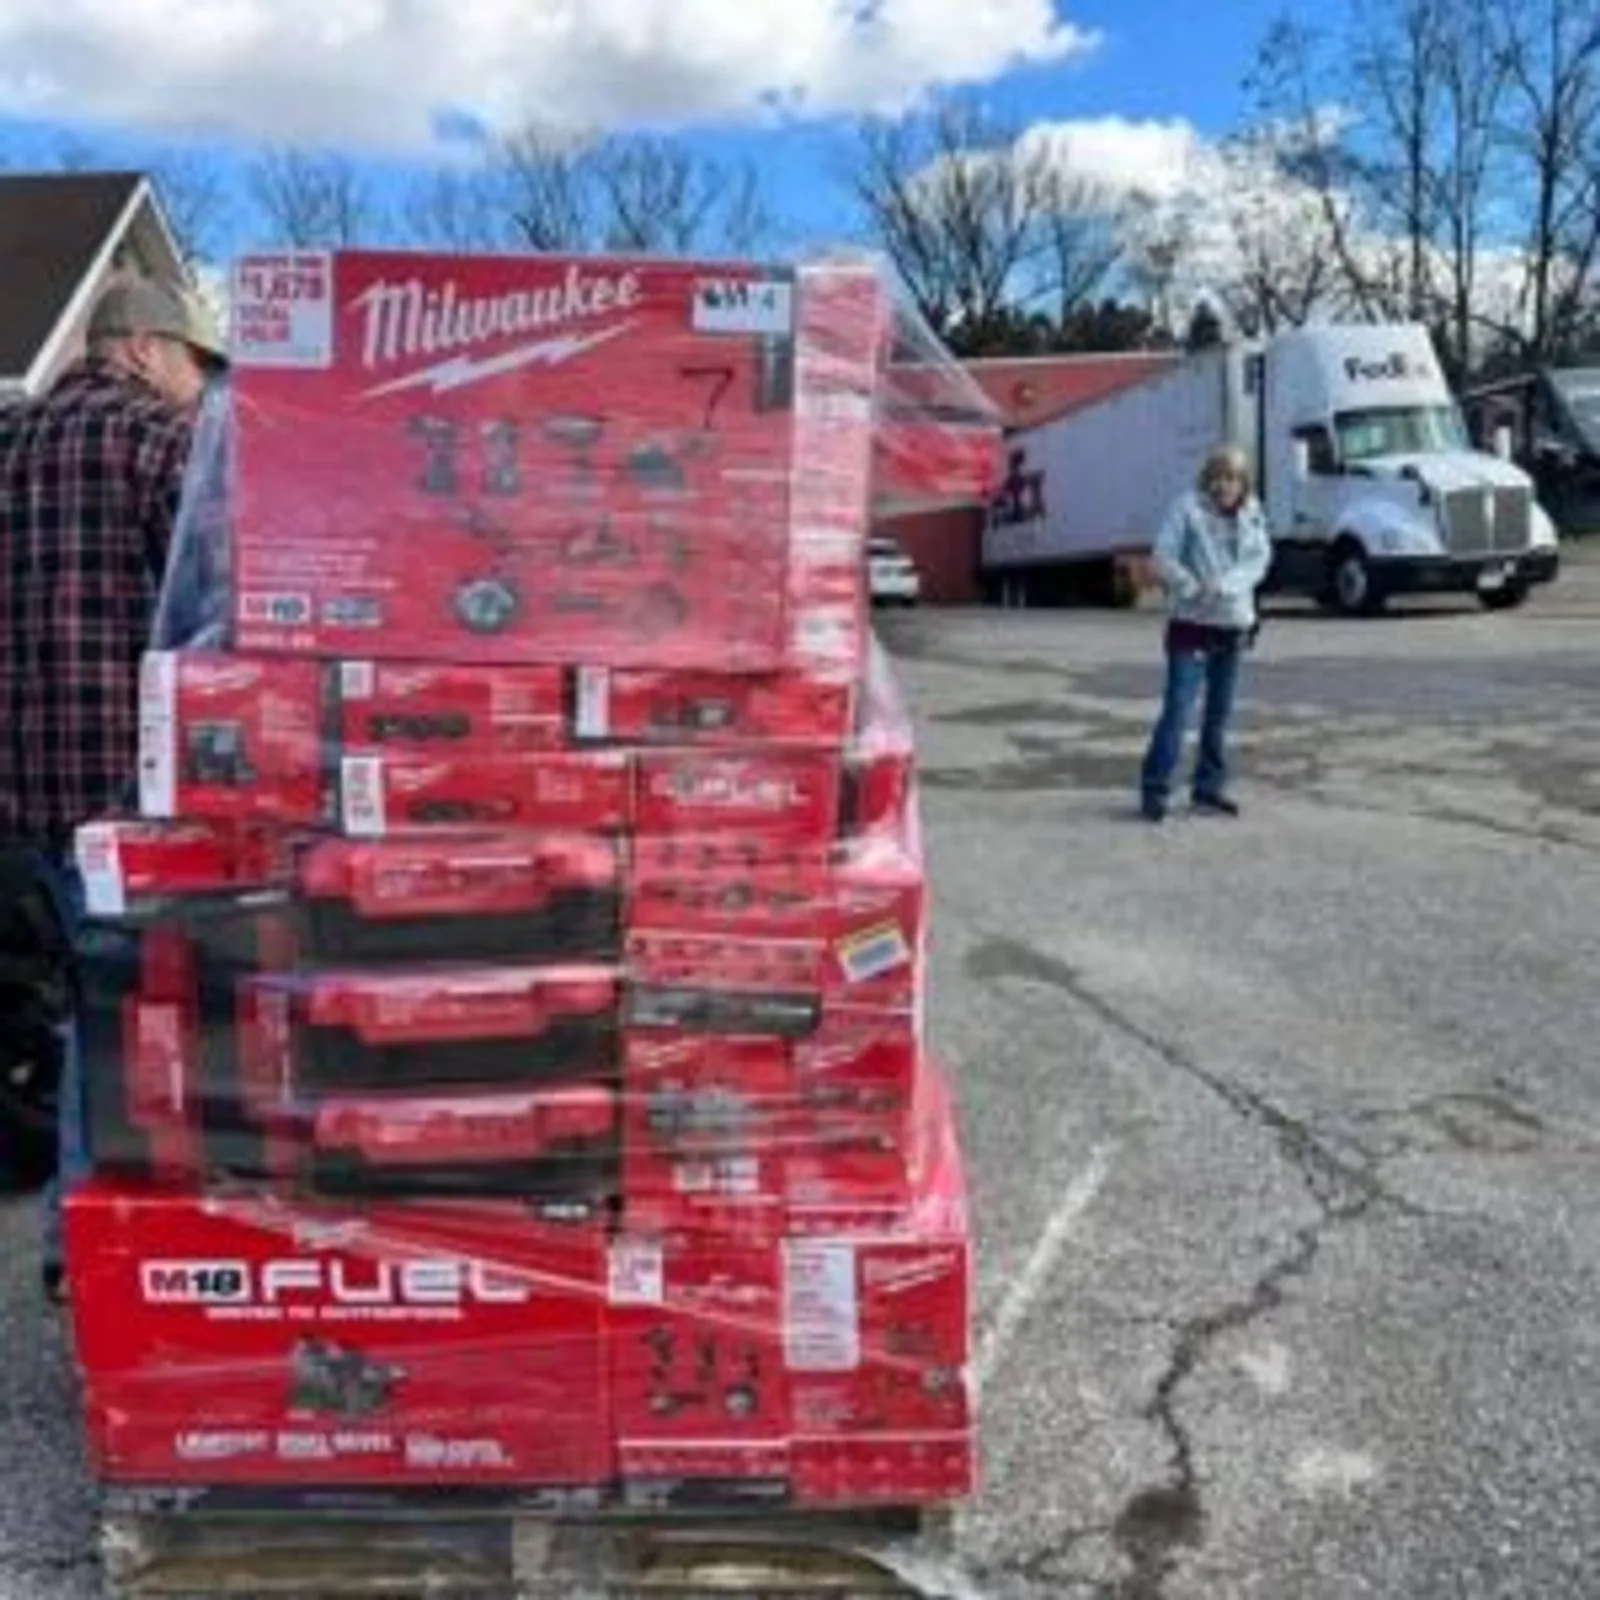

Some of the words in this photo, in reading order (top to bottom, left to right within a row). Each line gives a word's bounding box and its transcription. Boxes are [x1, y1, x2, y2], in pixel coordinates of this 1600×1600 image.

[345, 264, 640, 371] Milwaukee
[1342, 351, 1432, 381] Fed
[682, 366, 735, 430] 7
[149, 1268, 243, 1294] M18
[262, 1260, 528, 1303] FUEL
